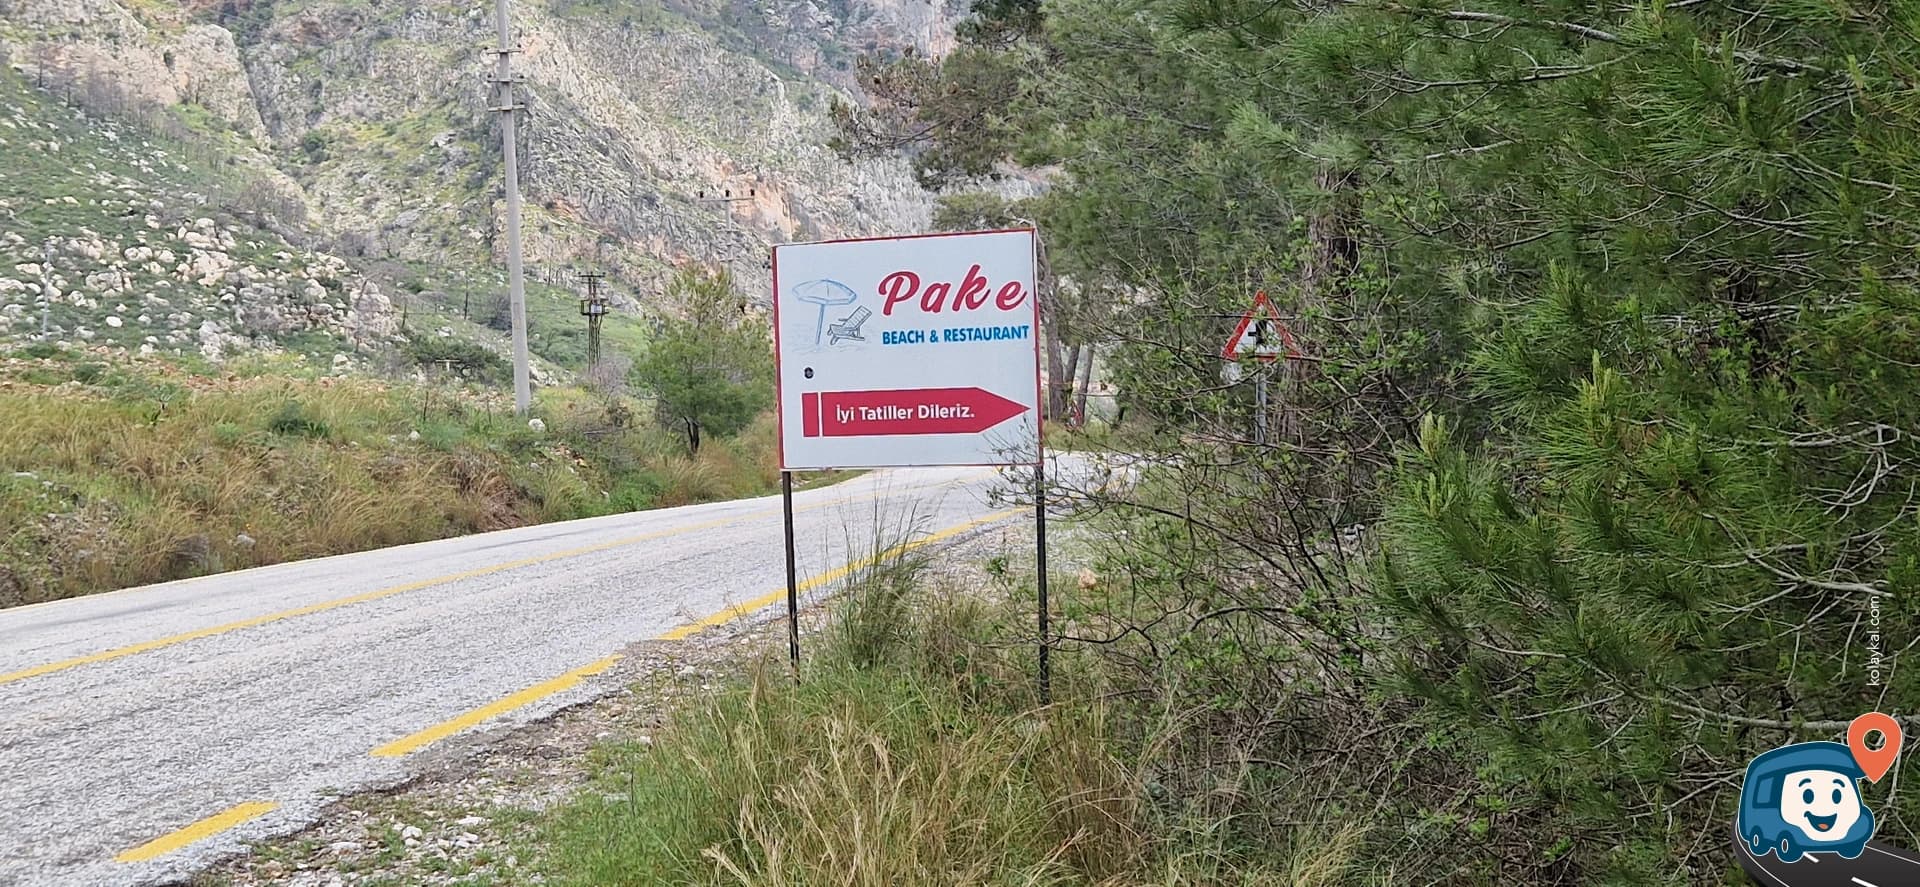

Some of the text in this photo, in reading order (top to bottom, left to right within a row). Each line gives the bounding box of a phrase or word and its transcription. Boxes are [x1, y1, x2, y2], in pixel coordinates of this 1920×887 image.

[878, 264, 1027, 316] Pake
[882, 325, 1029, 345] BEACH & RESTAURANT
[836, 403, 975, 424] İyi Tatiller Dileriz.
